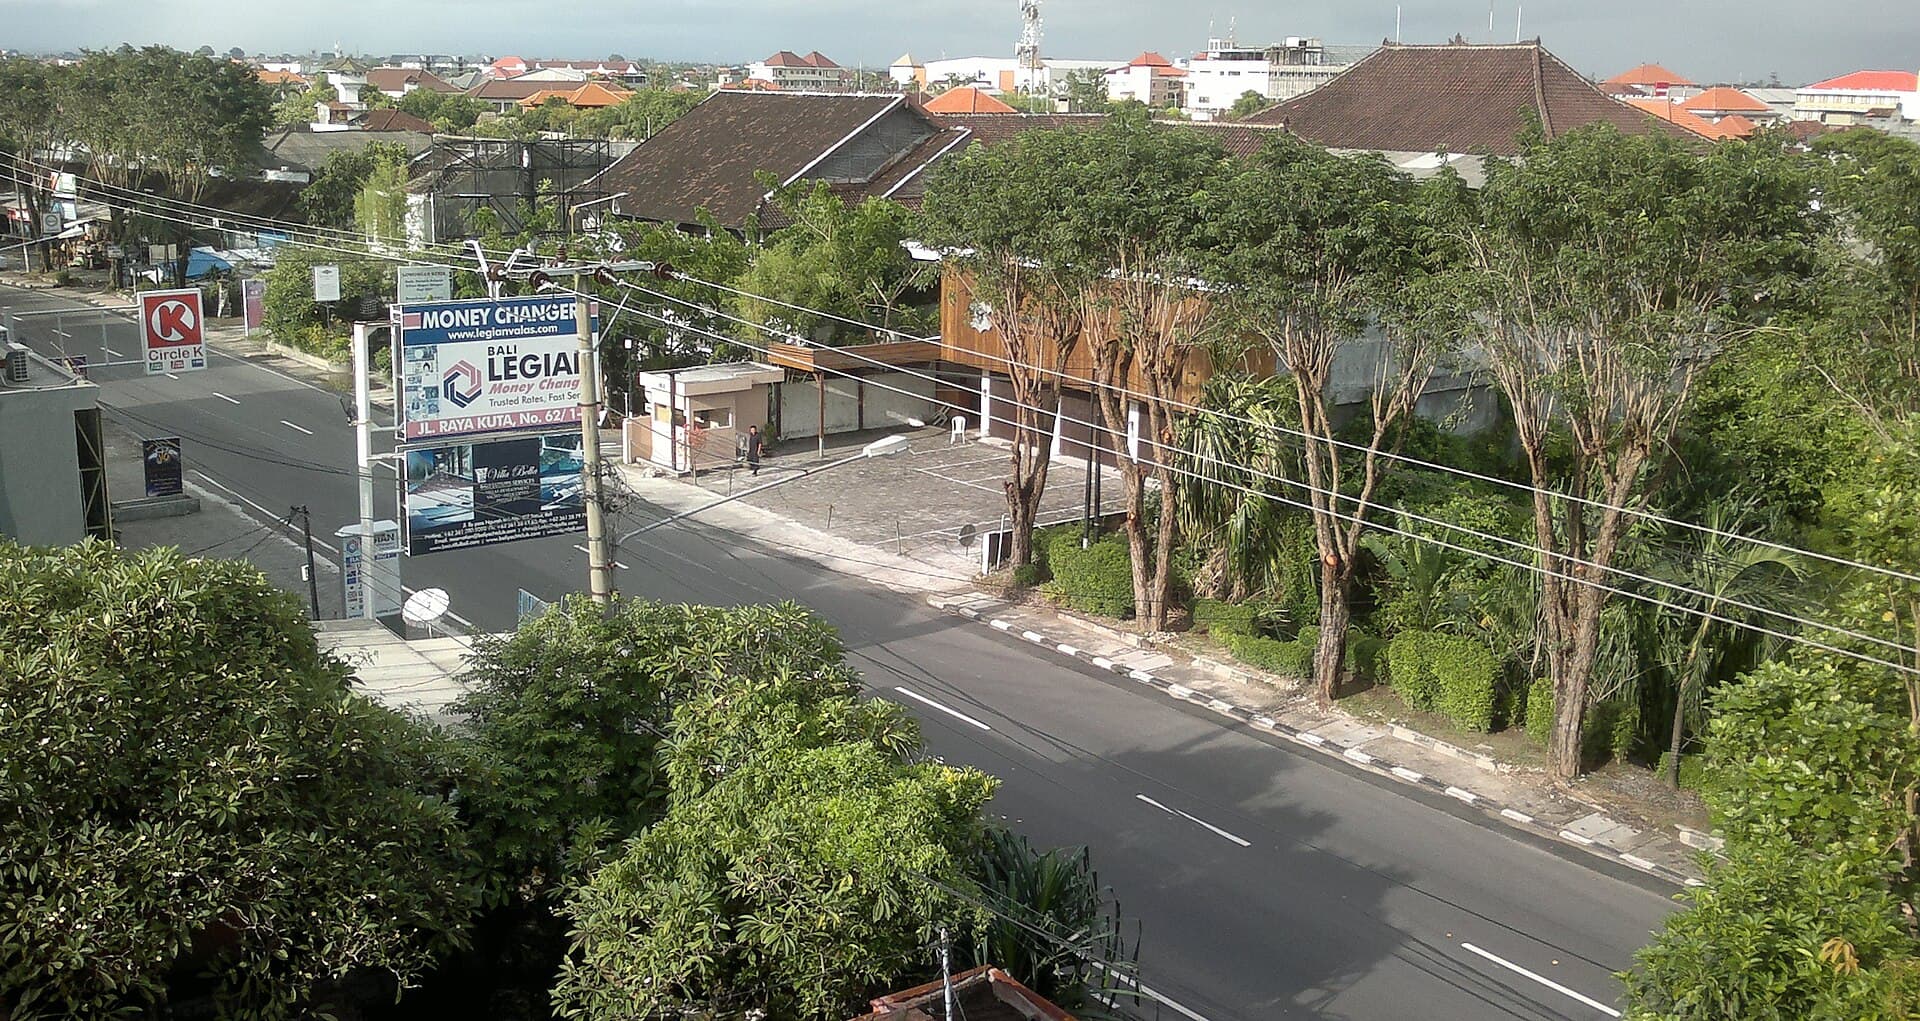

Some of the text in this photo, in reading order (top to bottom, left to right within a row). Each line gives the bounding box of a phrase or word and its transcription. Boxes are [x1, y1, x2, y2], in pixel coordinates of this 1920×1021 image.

[159, 304, 193, 338] K
[422, 303, 577, 330] MONEY CHANGER
[447, 325, 558, 341] www.legianvalas.com
[148, 346, 204, 361] Circle K
[488, 345, 517, 356] BALI
[489, 378, 580, 395] Money Chang
[489, 397, 519, 408] Trusted
[549, 393, 565, 401] Fast
[568, 392, 581, 400] Ser
[417, 422, 436, 435] JL.
[439, 418, 475, 433] RAYA
[477, 416, 516, 429] KUTA,
[520, 412, 542, 424] No.
